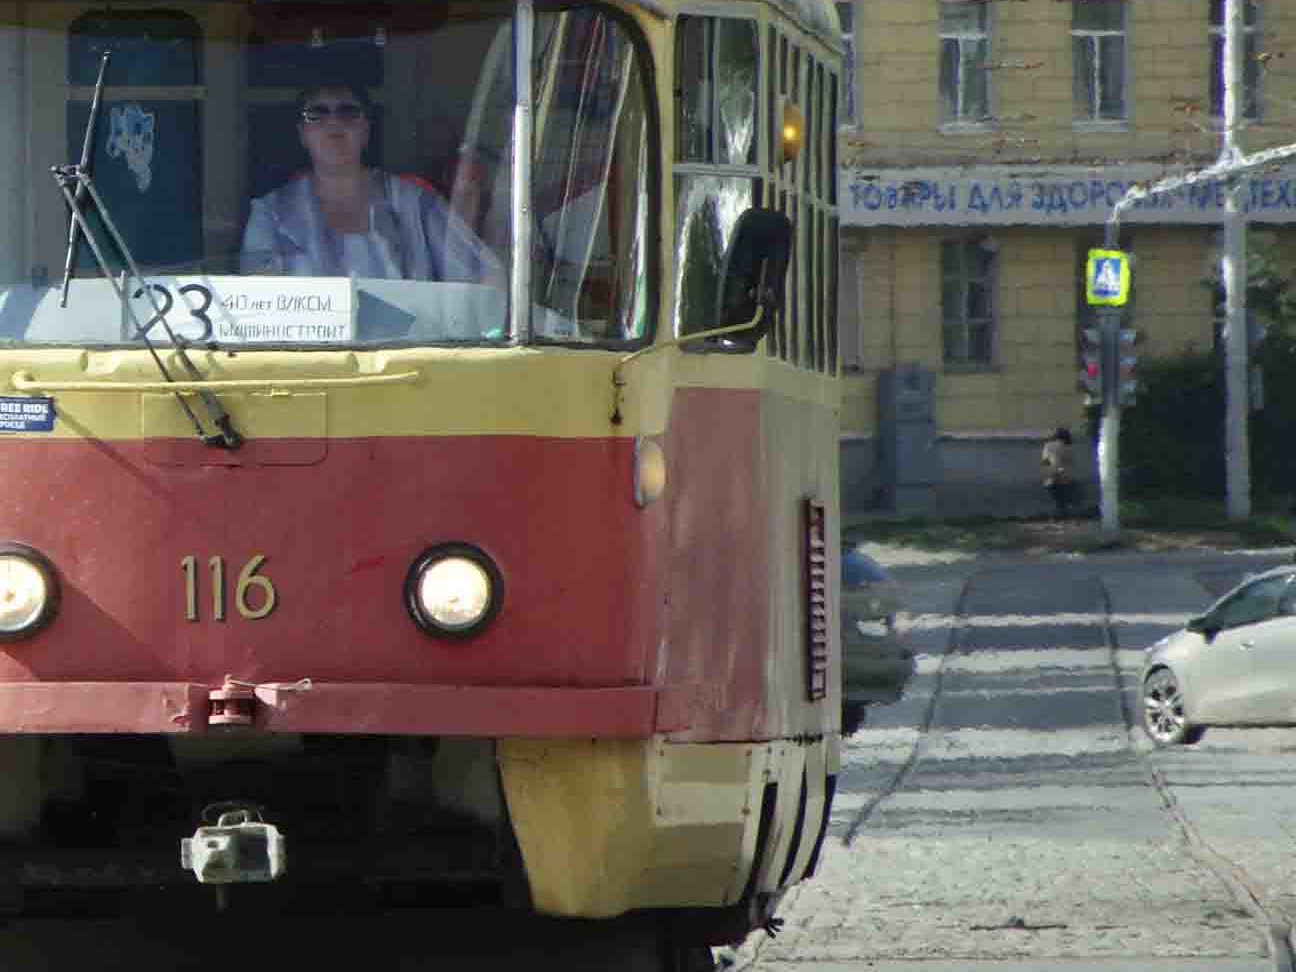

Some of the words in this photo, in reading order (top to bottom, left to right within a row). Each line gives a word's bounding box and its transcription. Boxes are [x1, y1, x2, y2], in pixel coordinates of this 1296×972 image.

[968, 182, 1024, 212] ДЛЯ
[132, 284, 215, 341] 23
[23, 403, 49, 413] RIDE
[181, 555, 277, 621] 116
